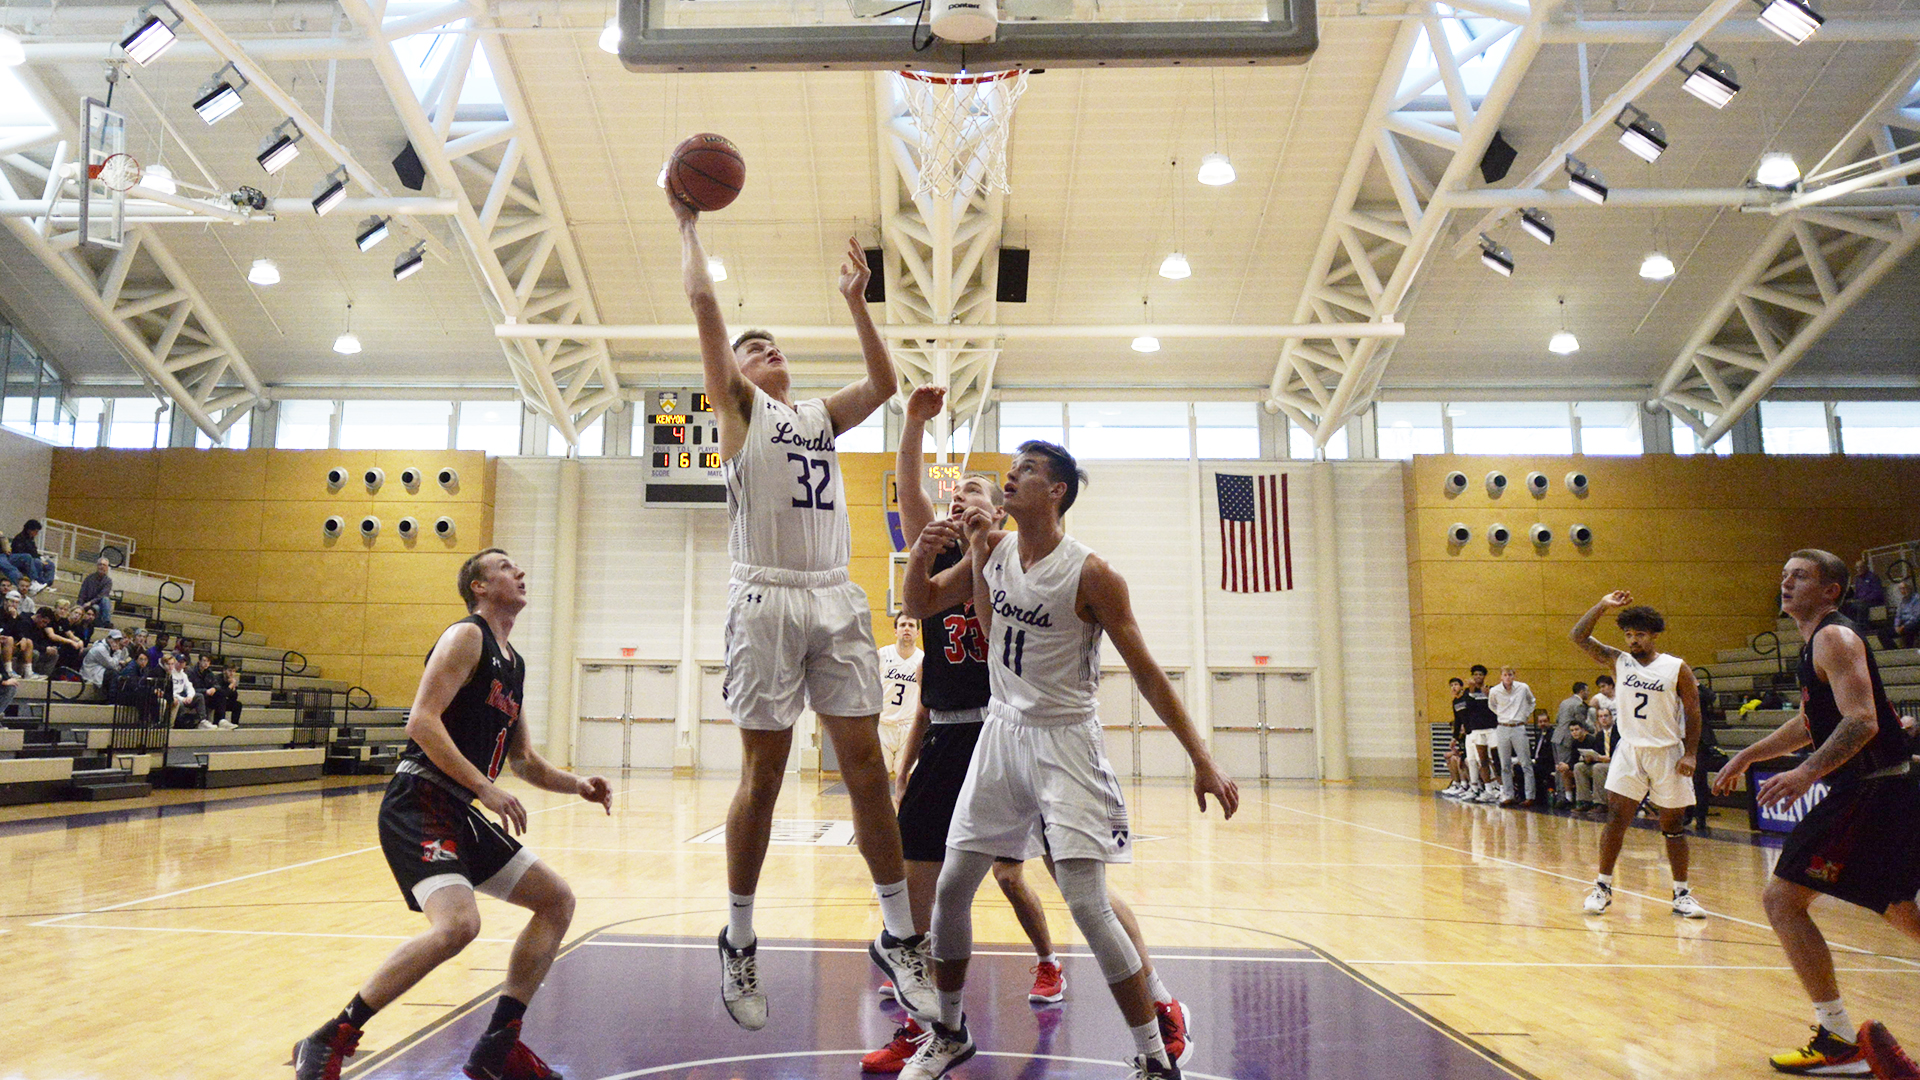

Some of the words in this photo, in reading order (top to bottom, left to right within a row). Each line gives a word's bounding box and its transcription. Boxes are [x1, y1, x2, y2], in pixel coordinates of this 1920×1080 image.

[655, 414, 686, 424] KENYON
[673, 426, 685, 444] 4
[770, 422, 836, 452] Lords
[663, 453, 669, 467] 1
[679, 452, 690, 468] 6
[706, 452, 721, 468] 10
[787, 452, 834, 510] 32
[928, 466, 961, 479] 15:45
[938, 480, 955, 499] 14
[990, 589, 1053, 628] Lords
[943, 614, 989, 664] 33
[1003, 625, 1026, 678] 11
[885, 668, 917, 683] Lords
[1623, 674, 1665, 692] Lords
[891, 683, 906, 706] 3
[1634, 692, 1649, 719] 2
[487, 727, 507, 781] 1
